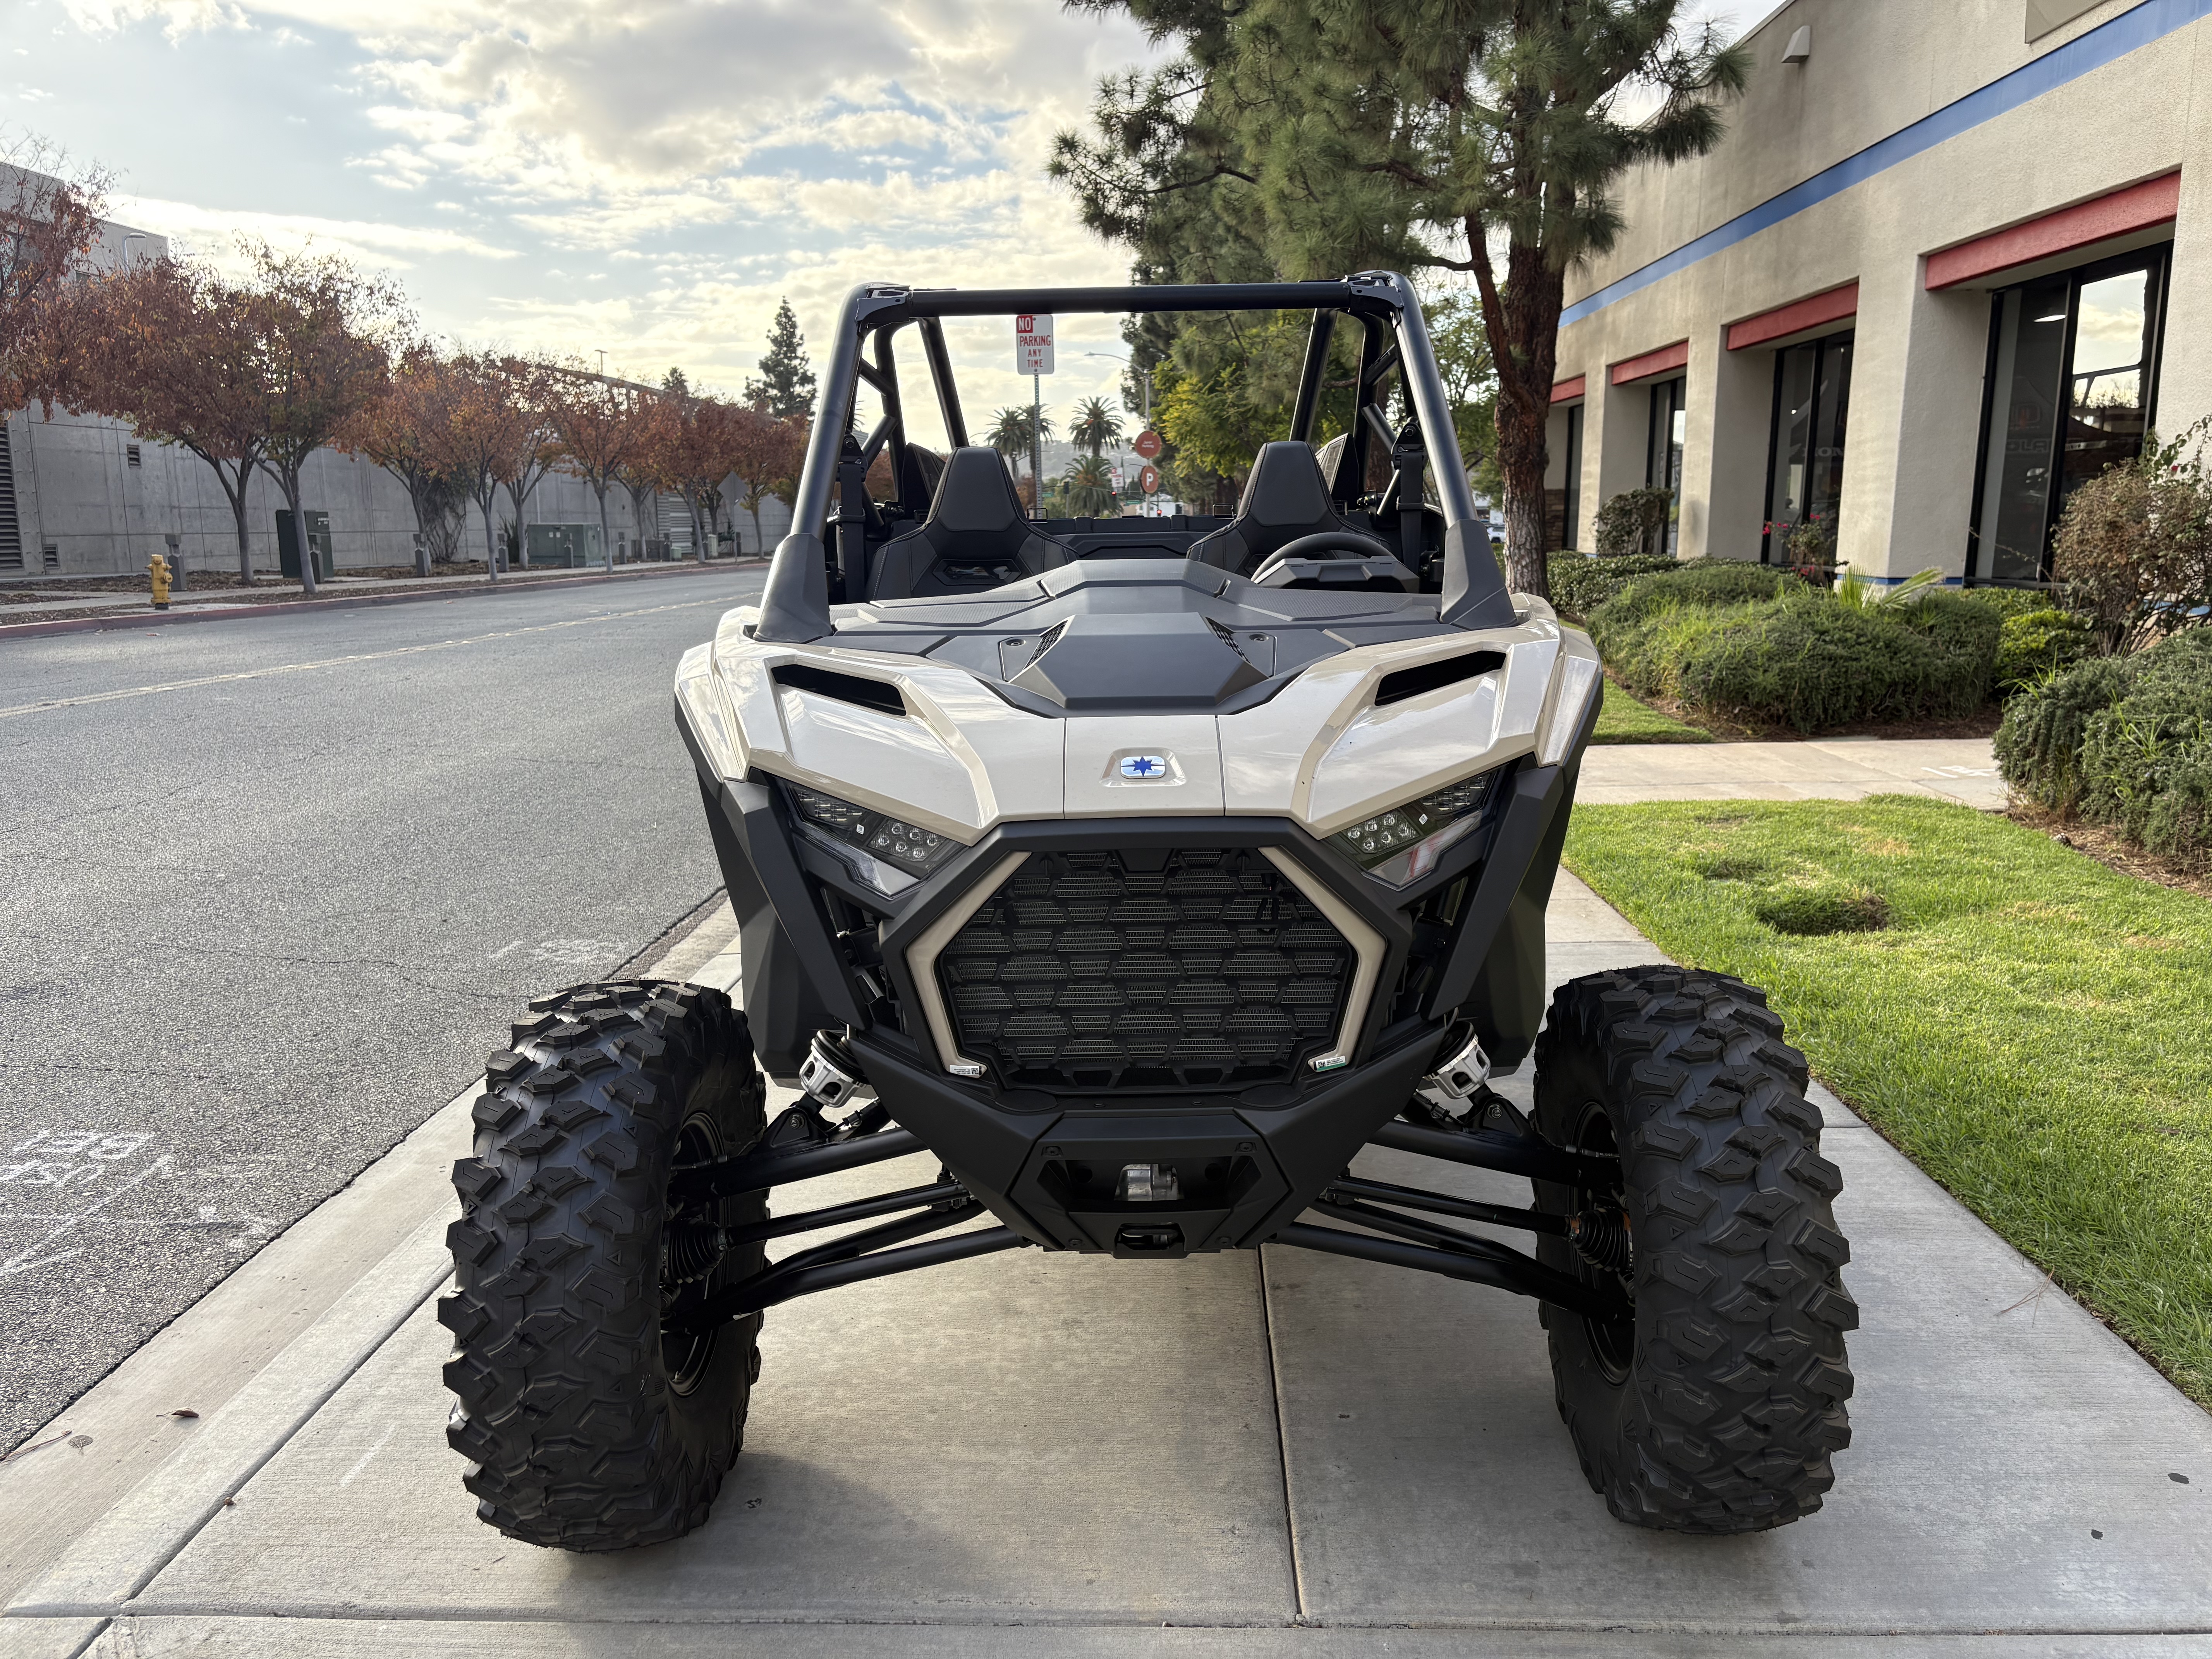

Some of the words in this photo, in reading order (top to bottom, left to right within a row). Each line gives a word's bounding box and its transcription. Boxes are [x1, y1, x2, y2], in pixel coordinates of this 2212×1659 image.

[1018, 318, 1031, 330] NO
[1020, 335, 1051, 347] PARKING
[1028, 349, 1042, 357] ANY
[1027, 359, 1043, 368] TIME
[1146, 473, 1154, 486] P
